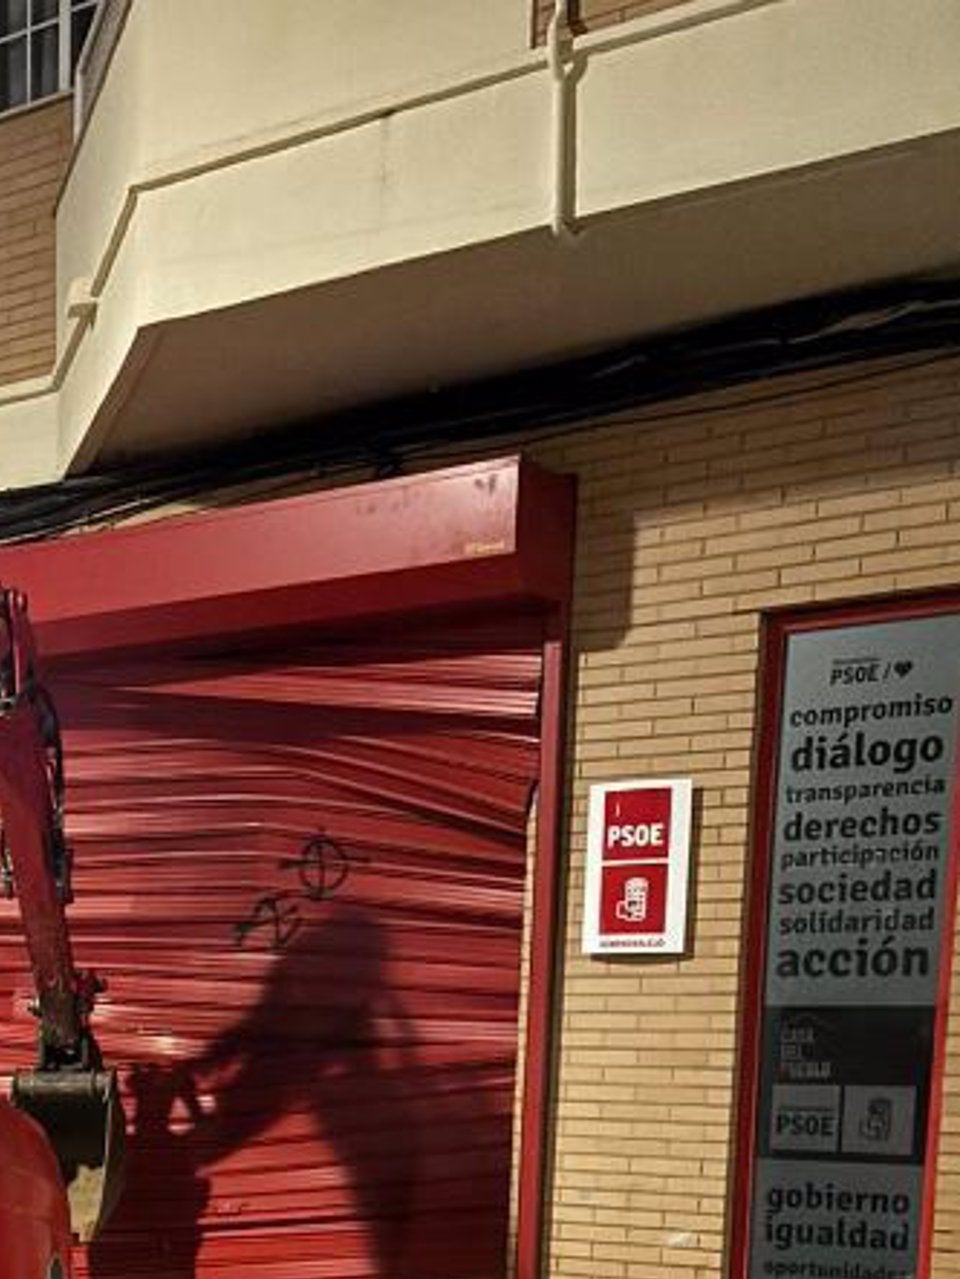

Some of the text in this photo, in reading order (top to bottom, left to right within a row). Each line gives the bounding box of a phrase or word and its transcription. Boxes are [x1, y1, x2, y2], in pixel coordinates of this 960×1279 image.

[791, 695, 953, 727] compromiso
[791, 733, 944, 773] diálogo
[786, 774, 946, 805] transparencia
[607, 822, 664, 848] PSOE
[783, 807, 941, 842] derechos
[779, 838, 940, 872] participación
[778, 869, 936, 904] sociedad
[778, 906, 936, 936] solidaridad
[774, 935, 929, 978] acción
[776, 1112, 834, 1137] PSOE
[768, 1183, 910, 1216] gobierno
[766, 1210, 910, 1251] igualdad
